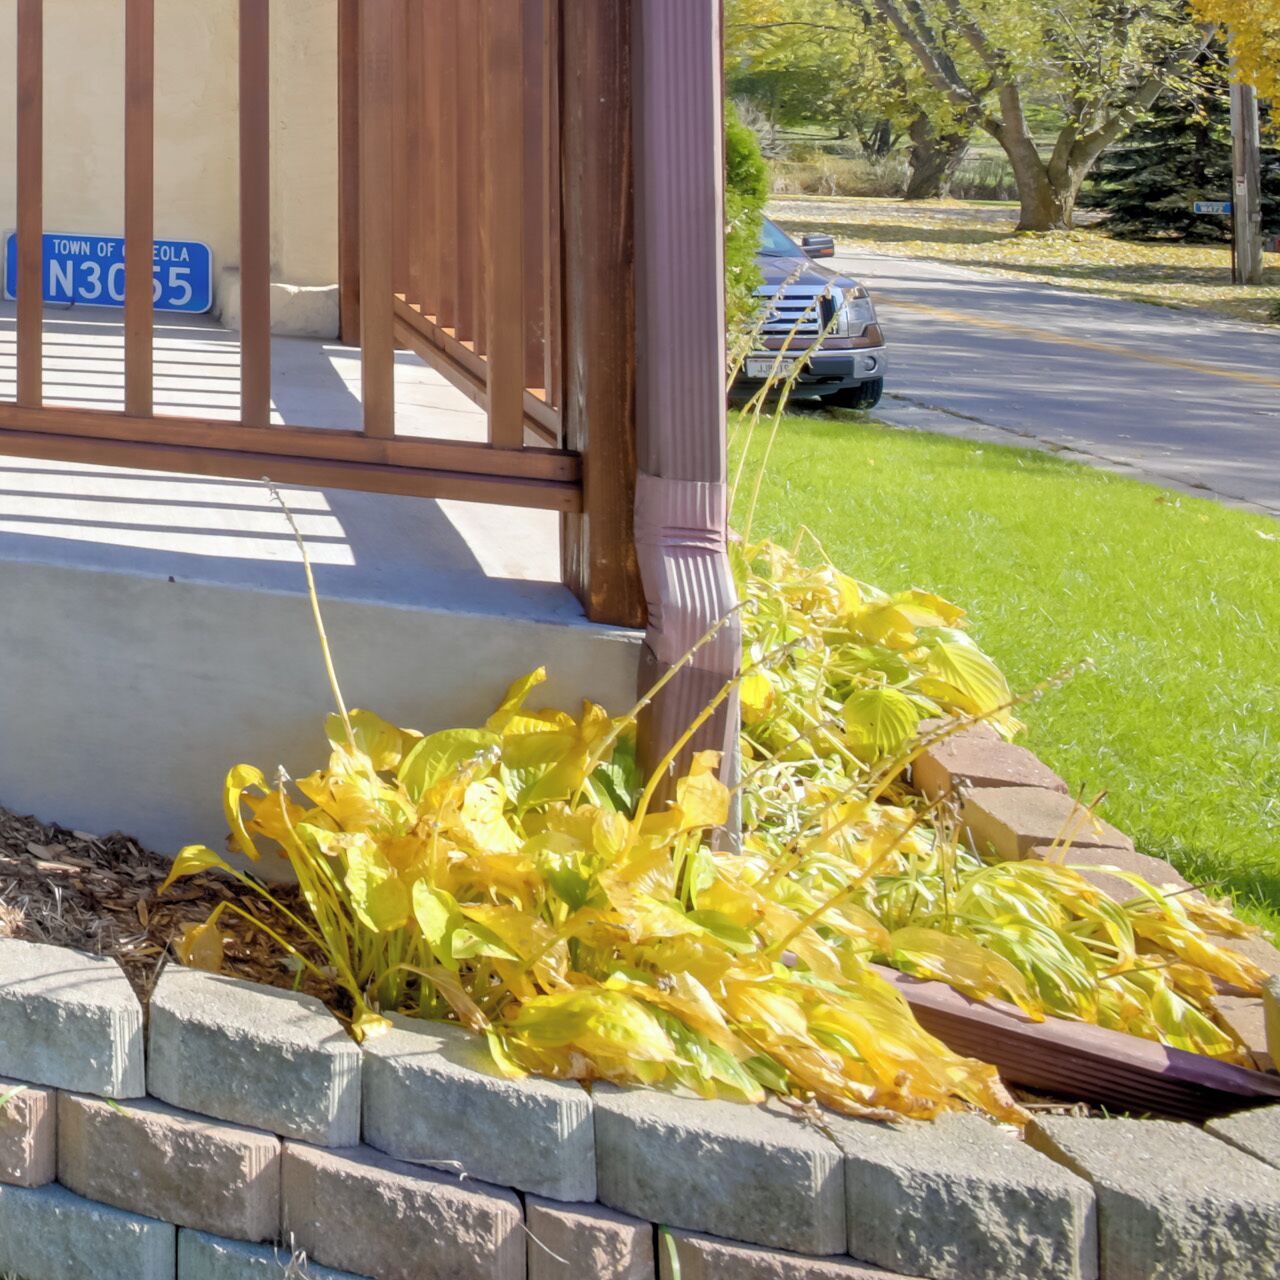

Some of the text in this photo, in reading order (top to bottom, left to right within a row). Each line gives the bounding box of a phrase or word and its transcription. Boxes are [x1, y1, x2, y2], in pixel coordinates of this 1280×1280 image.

[52, 238, 190, 262] TOWN OF EOLA
